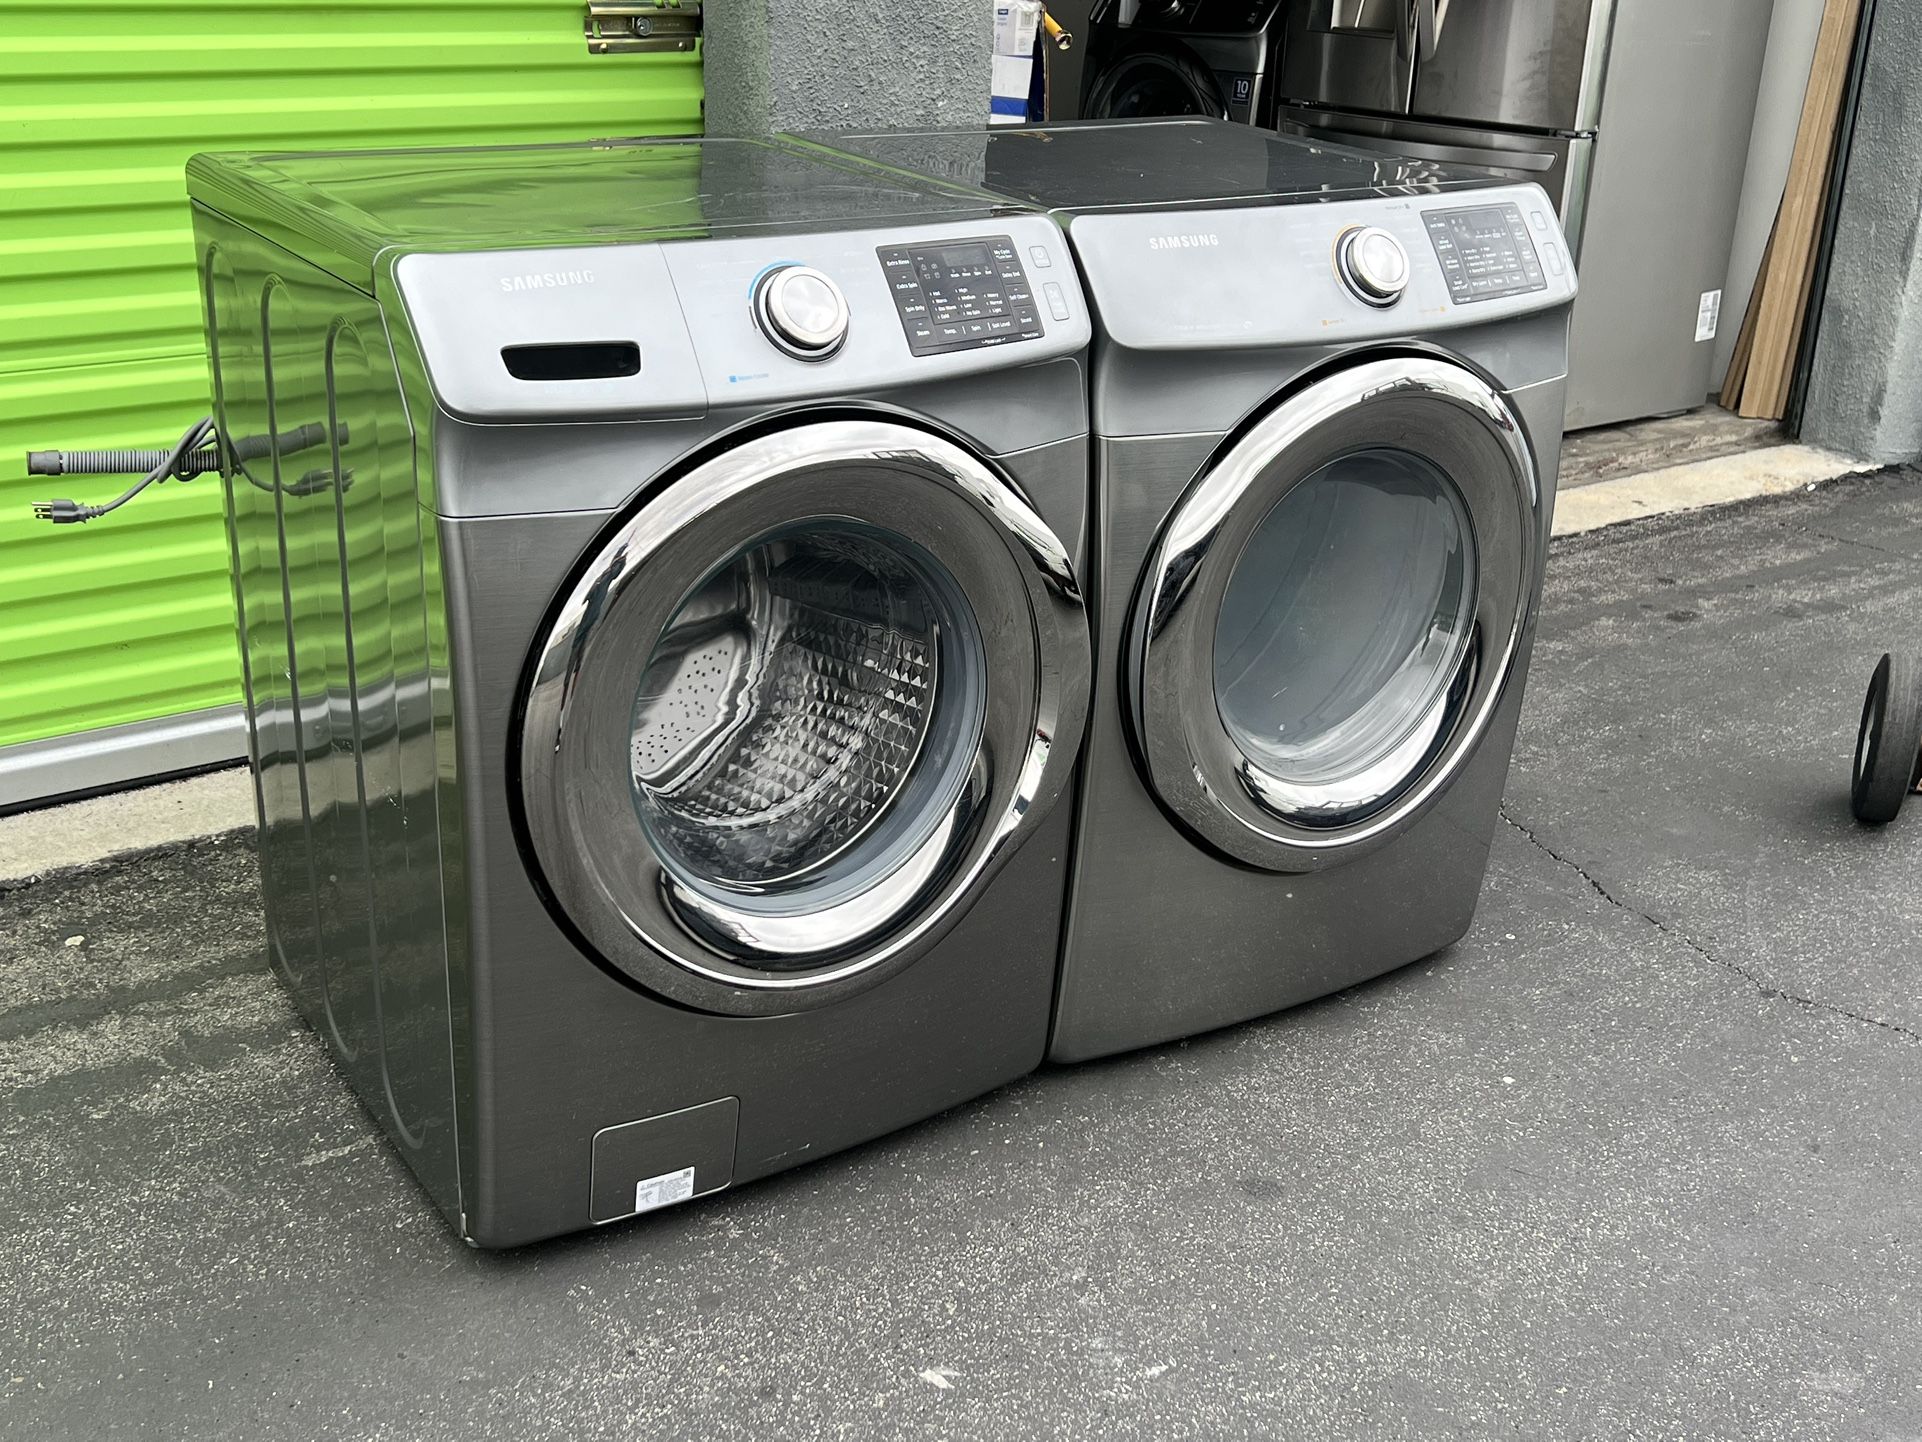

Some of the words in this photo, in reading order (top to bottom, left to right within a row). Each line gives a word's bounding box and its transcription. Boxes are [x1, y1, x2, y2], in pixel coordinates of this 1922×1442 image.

[1237, 80, 1249, 94] 10
[1149, 234, 1219, 250] SAMSUNG
[499, 269, 595, 292] SAMSUNG
